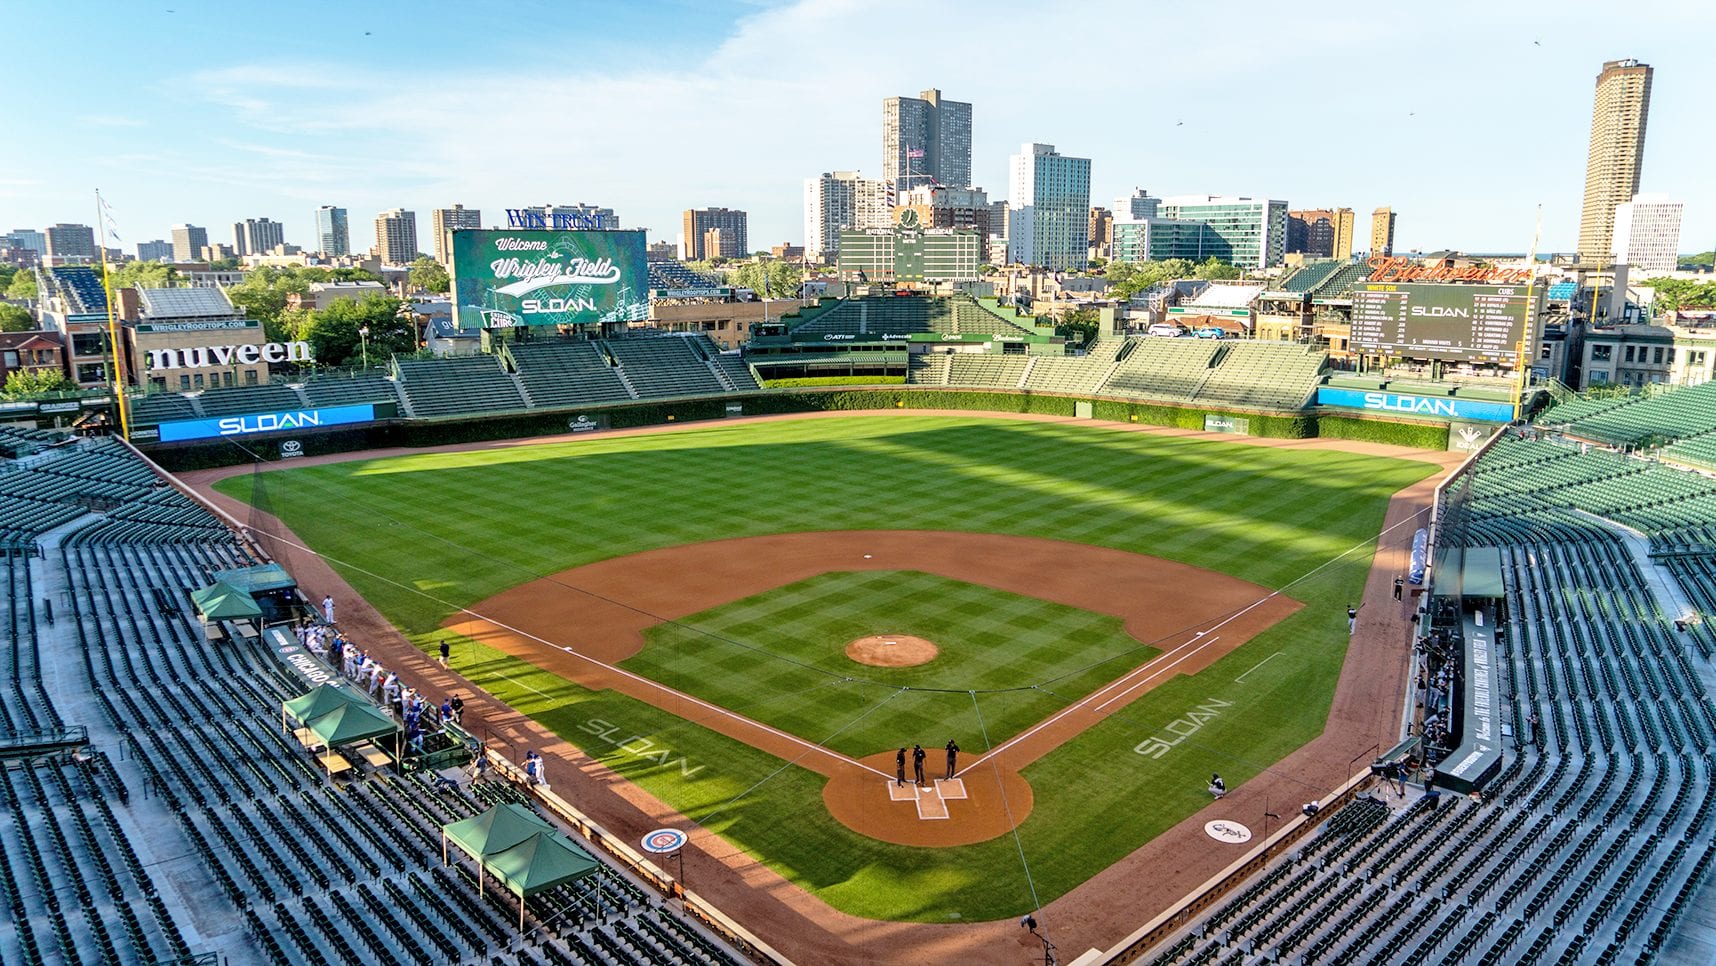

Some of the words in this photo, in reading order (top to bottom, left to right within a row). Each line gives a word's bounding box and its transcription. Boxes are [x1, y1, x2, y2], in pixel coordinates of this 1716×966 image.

[505, 209, 605, 229] WINTRUST
[495, 237, 547, 251] Welcome
[490, 257, 560, 282] Wrigley
[566, 257, 613, 277] Field
[1367, 256, 1533, 282] Budweiser
[151, 321, 246, 332] WRIGLEYROOFTOPS.COM
[149, 341, 312, 370] nuveen
[568, 420, 597, 428] Gallagher
[1456, 441, 1480, 449] IDEAL
[287, 654, 330, 683] CHICAGO
